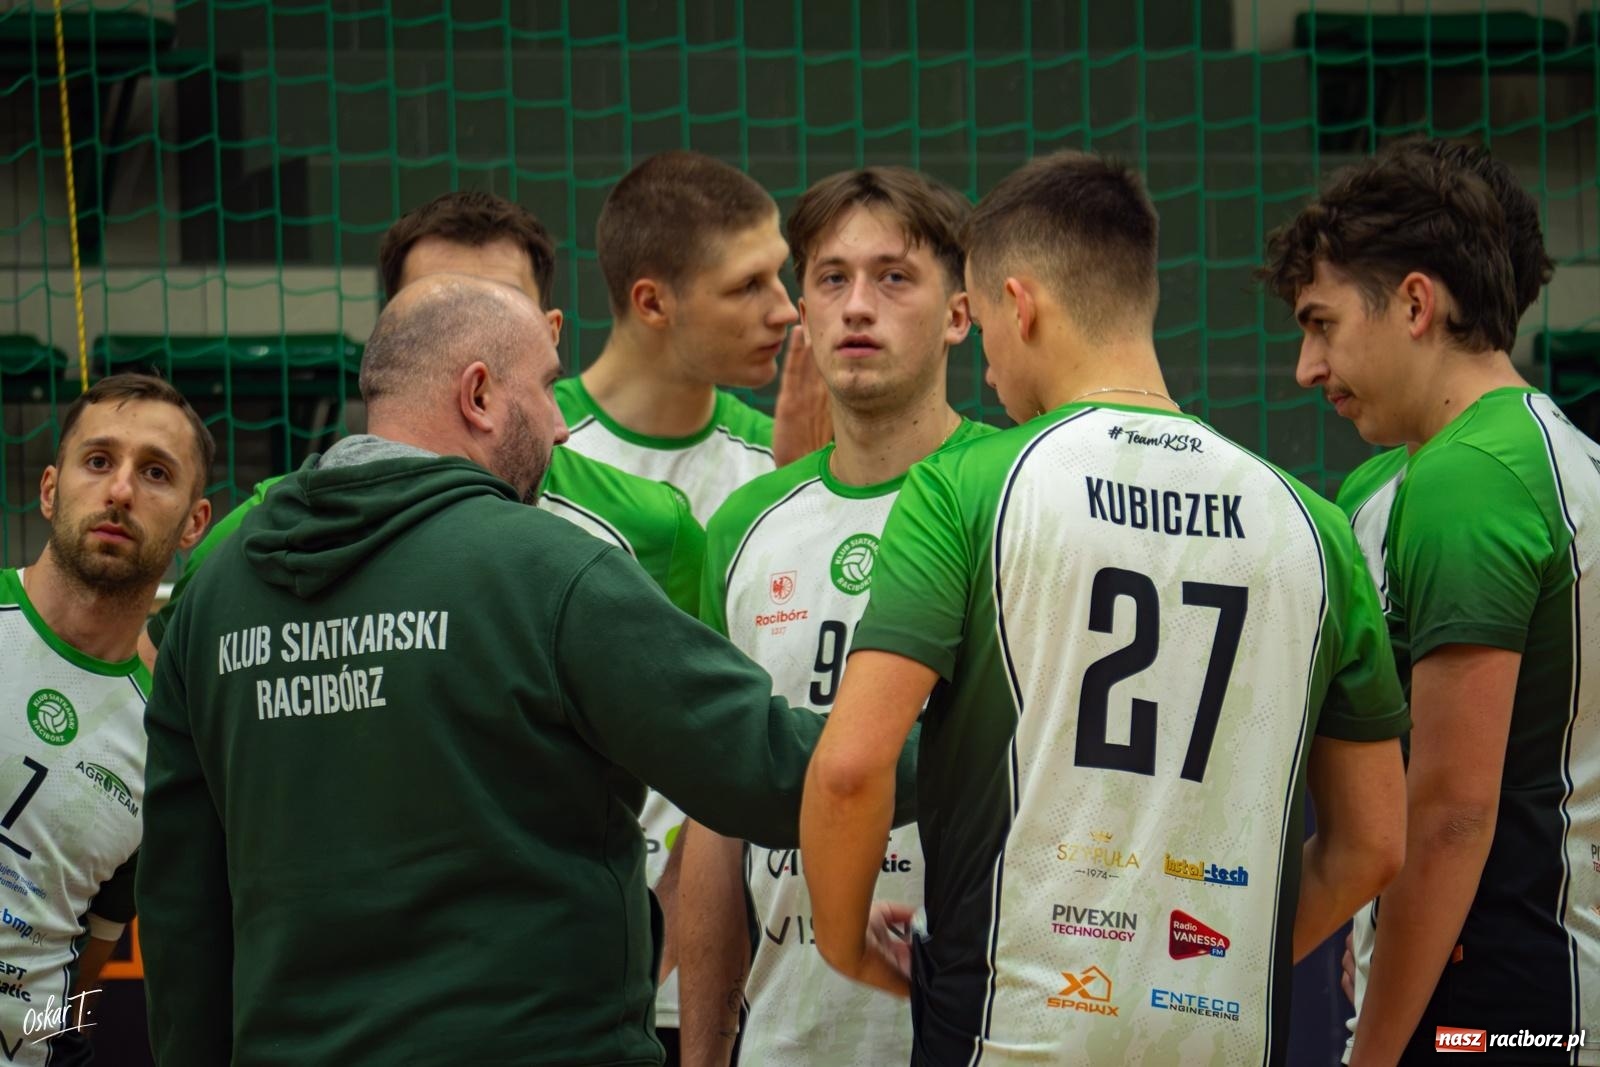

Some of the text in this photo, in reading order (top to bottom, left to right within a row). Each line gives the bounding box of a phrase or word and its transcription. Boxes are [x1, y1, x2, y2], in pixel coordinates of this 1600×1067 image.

[1085, 476, 1246, 539] KUBICZEK
[756, 609, 808, 626] Racibórz
[219, 611, 449, 675] KLUB SIATKARSKI
[1074, 567, 1248, 783] 27
[256, 664, 387, 720] RACIBÓRZ
[1087, 868, 1108, 880] 1974
[1052, 904, 1137, 930] PIVEXIN
[1173, 920, 1197, 932] Radio
[1052, 923, 1135, 942] TECHNOLOGY
[1173, 931, 1226, 948] VANESSA
[1212, 948, 1224, 957] FM
[1047, 997, 1119, 1017] SPAWX
[1151, 989, 1240, 1014] ENTECO
